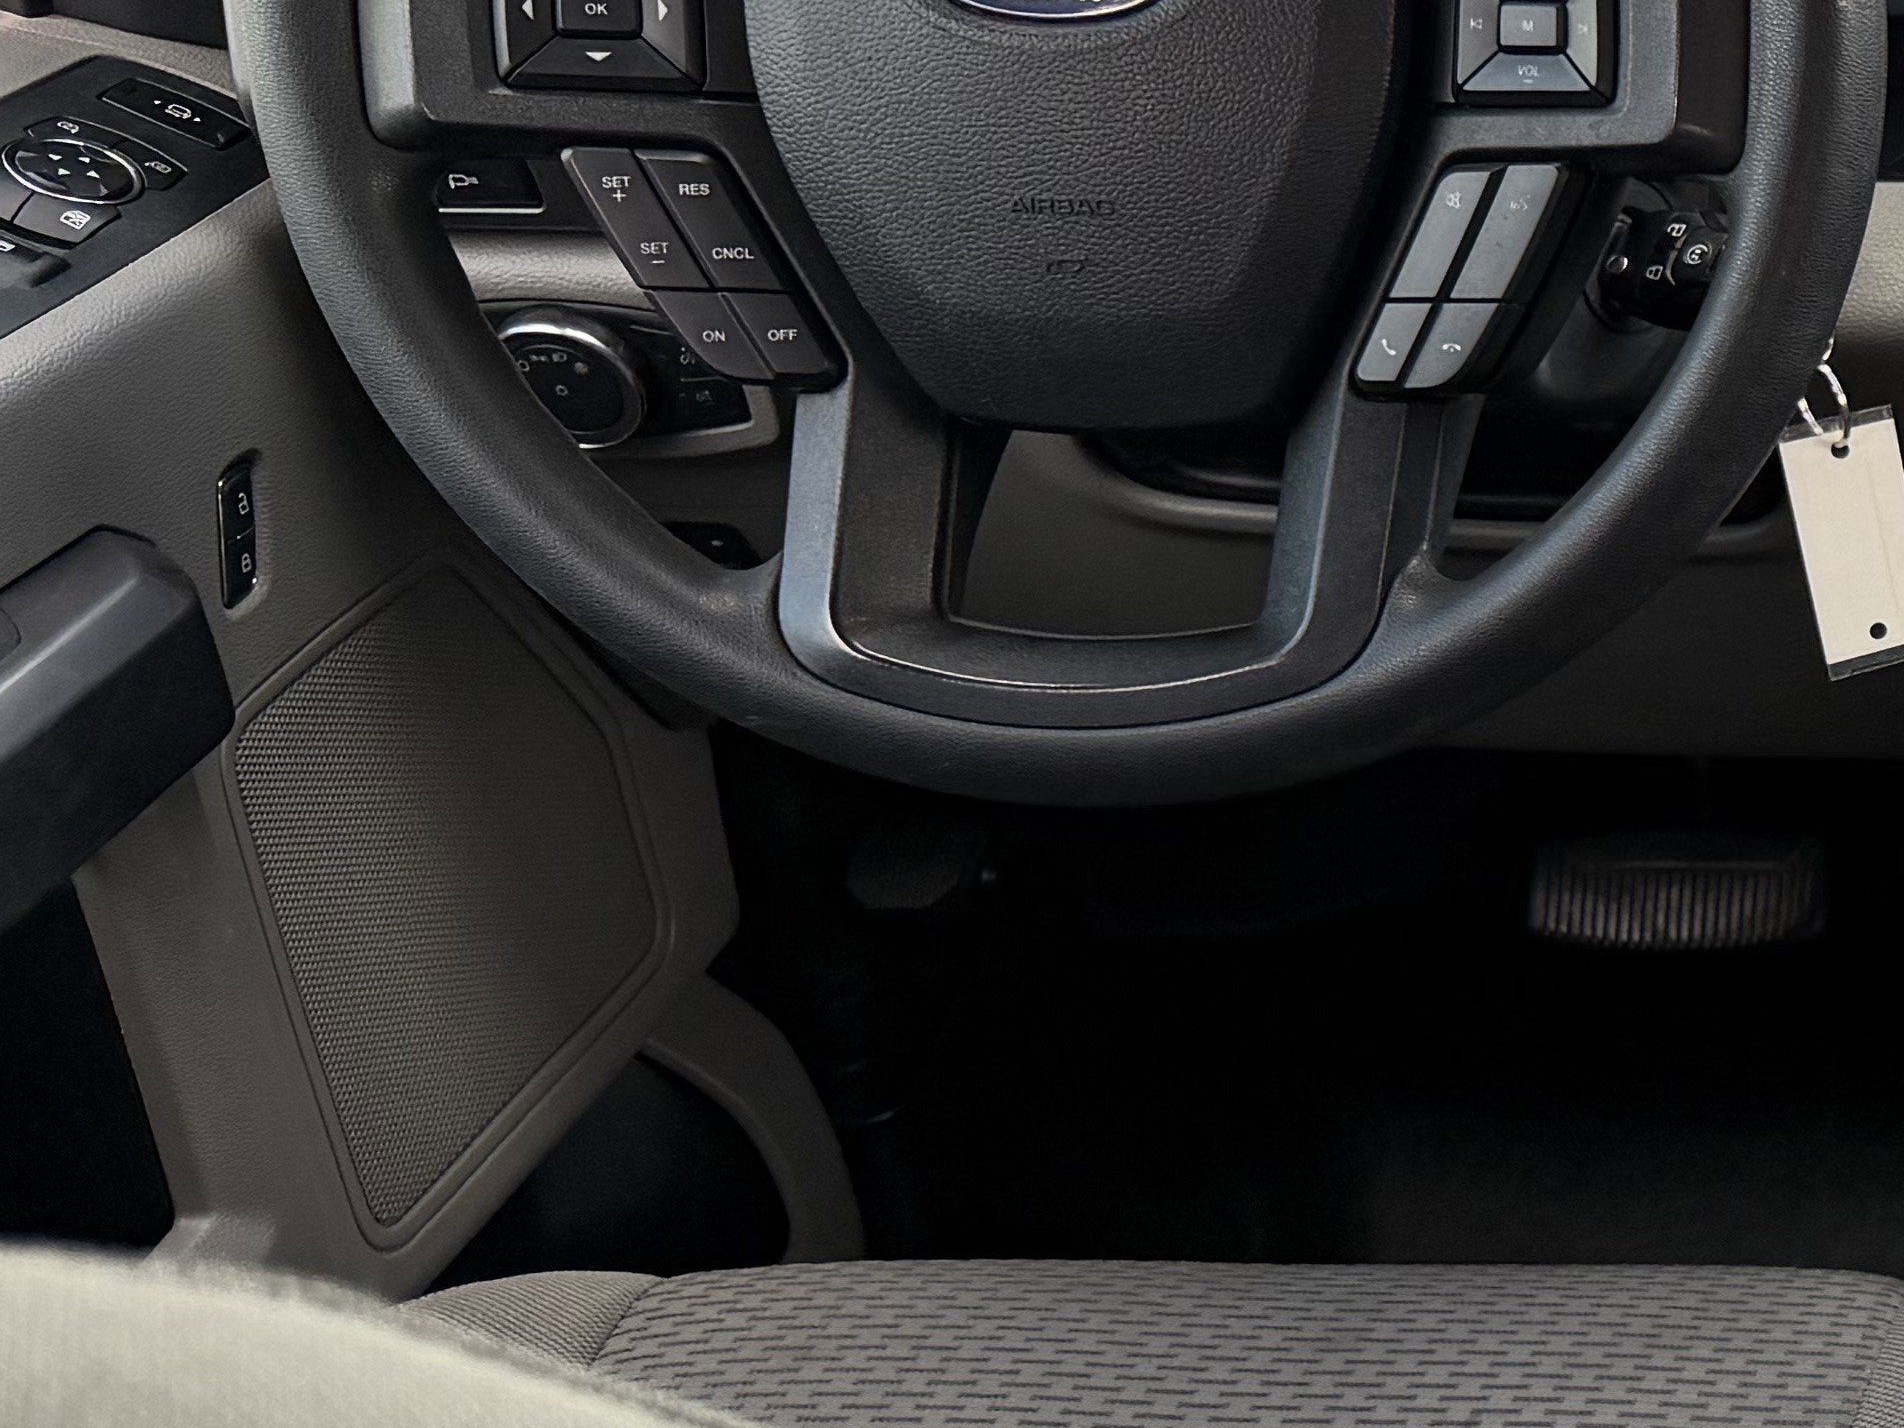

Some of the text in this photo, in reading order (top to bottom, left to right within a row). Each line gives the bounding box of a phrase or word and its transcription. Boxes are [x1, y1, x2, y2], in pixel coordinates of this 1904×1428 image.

[584, 2, 608, 16] OK
[1522, 20, 1533, 31] M
[1518, 64, 1539, 77] VOL
[602, 175, 631, 189] SET
[678, 182, 710, 196] RES
[1010, 198, 1115, 217] AIRBAG
[640, 241, 669, 255] SET
[712, 247, 754, 260] CNCL
[702, 329, 725, 343] ON
[767, 329, 798, 341] OFF
